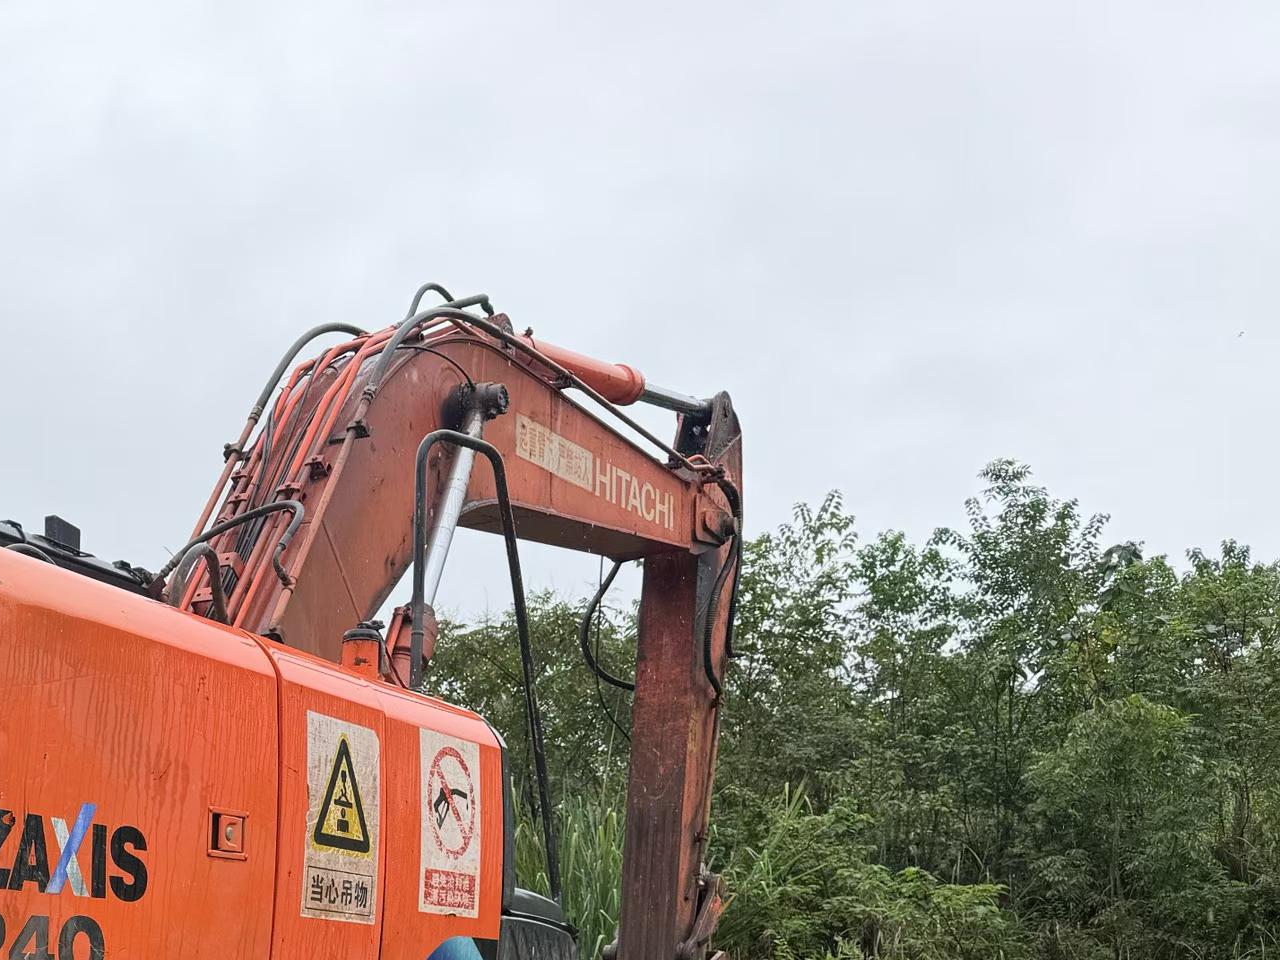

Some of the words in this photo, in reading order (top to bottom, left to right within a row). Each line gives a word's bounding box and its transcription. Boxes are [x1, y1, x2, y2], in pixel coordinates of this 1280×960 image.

[595, 458, 673, 531] HITACHI
[310, 873, 369, 909] 当心吊物
